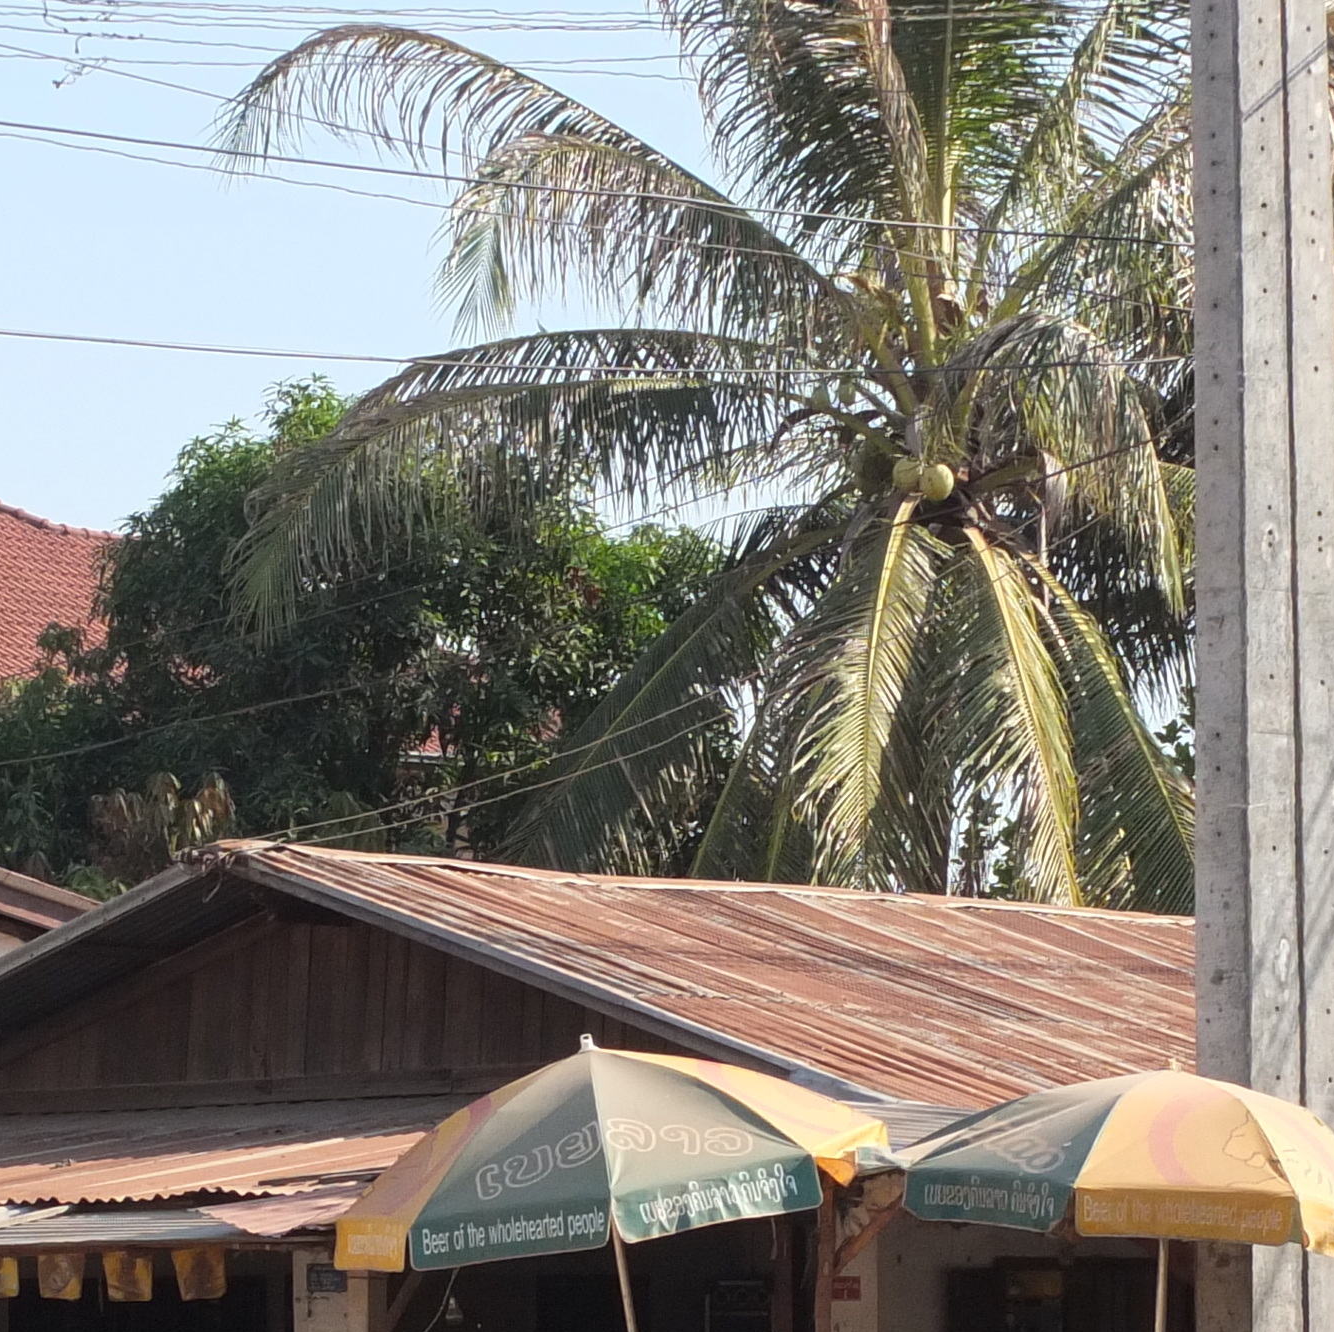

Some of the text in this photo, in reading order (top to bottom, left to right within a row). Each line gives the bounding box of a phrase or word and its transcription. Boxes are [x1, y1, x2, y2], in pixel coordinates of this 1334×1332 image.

[422, 1228, 450, 1255] Beer
[453, 1222, 465, 1251] of
[467, 1222, 486, 1249] the
[488, 1210, 564, 1245] wholehearted
[567, 1205, 606, 1242] people
[1083, 1195, 1113, 1222] Beer
[1117, 1196, 1129, 1223] of
[1132, 1197, 1152, 1223] the
[1240, 1208, 1283, 1237] people
